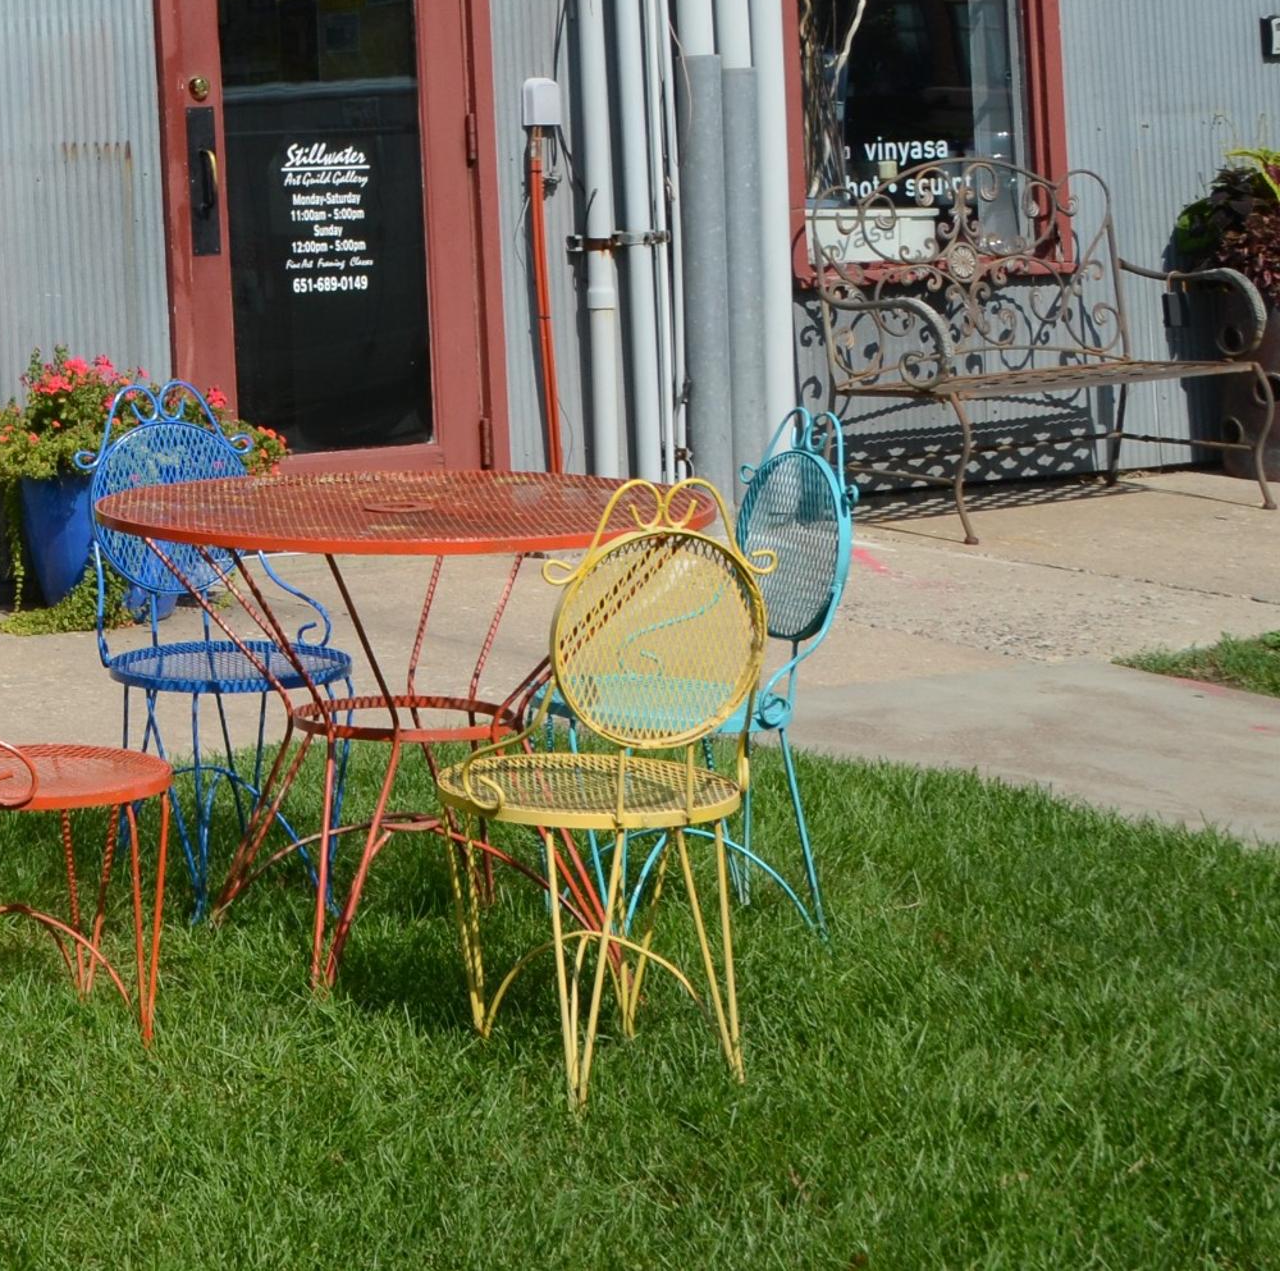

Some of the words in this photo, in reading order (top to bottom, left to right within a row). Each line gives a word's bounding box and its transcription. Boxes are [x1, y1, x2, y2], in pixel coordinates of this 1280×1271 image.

[284, 142, 366, 167] Stillwater
[864, 136, 948, 166] vinyasa
[284, 172, 301, 186] Art
[302, 171, 331, 187] Guild
[332, 170, 369, 188] Gallery
[845, 175, 880, 198] hot
[292, 192, 361, 206] Monday-Saturday
[290, 209, 326, 222] 11:00am
[333, 207, 365, 221] 5:00pm
[313, 223, 344, 238] Sunday
[291, 240, 328, 254] 12:00pm
[334, 238, 367, 253] 5:00pm
[292, 275, 369, 294] 651-689-0149
